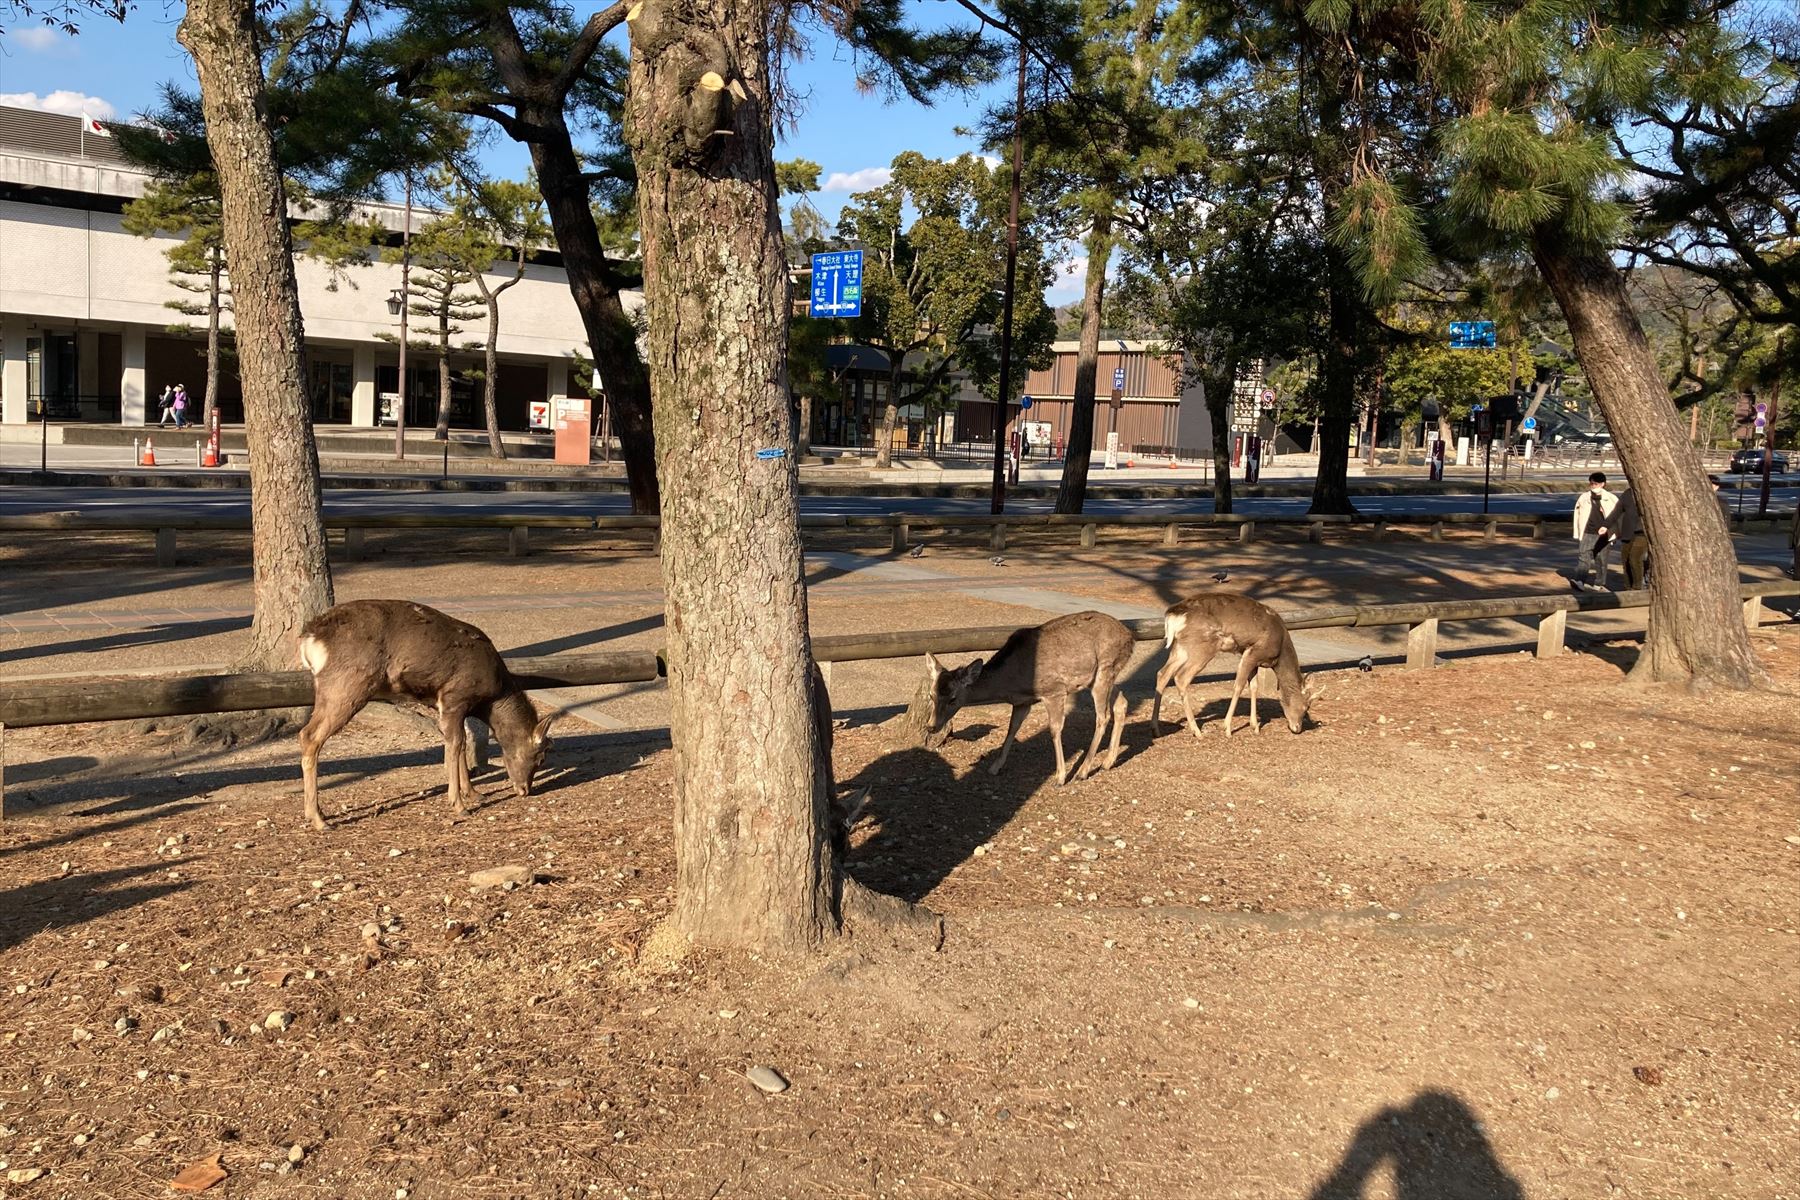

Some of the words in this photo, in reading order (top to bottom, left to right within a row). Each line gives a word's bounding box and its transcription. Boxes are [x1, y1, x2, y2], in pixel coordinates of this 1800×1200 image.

[844, 254, 858, 263] 東大寺
[558, 410, 566, 420] P
